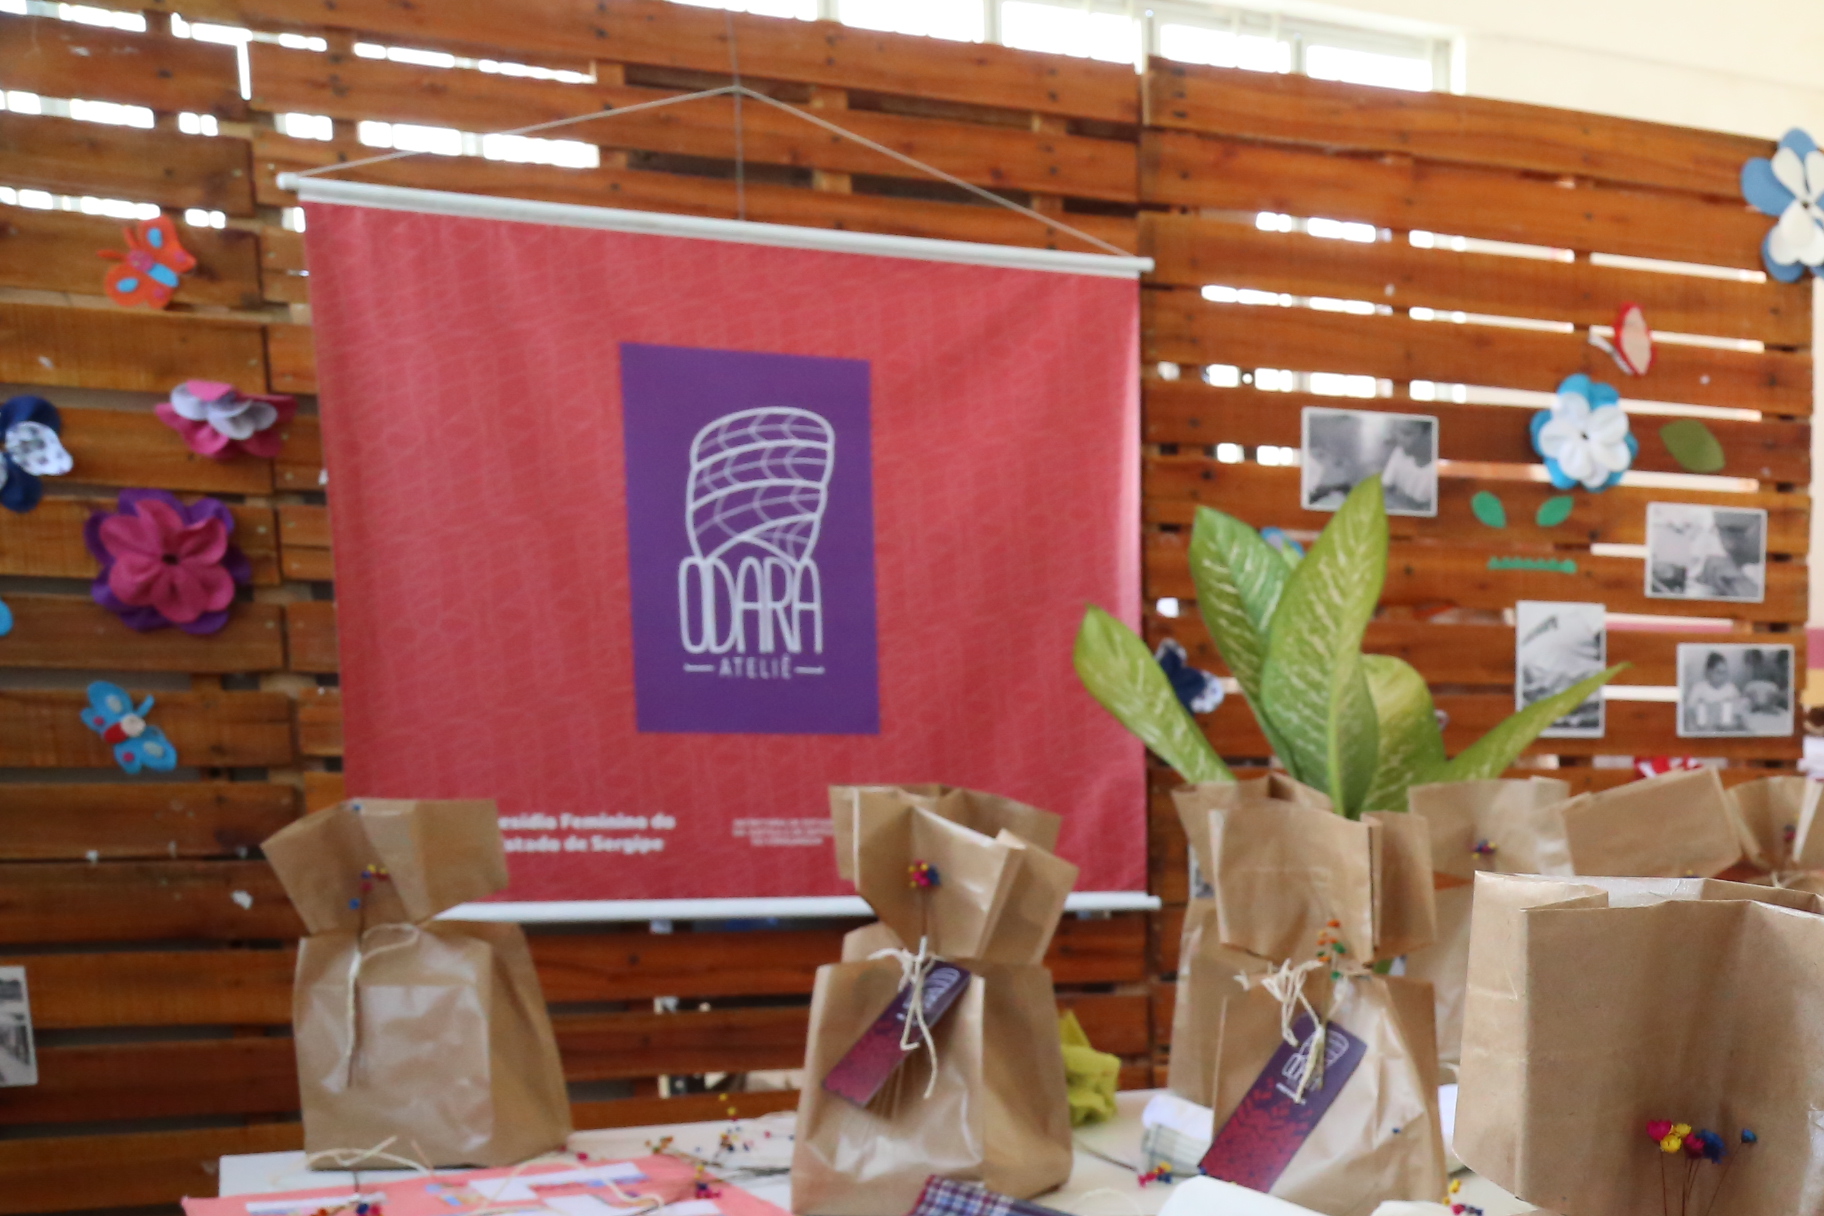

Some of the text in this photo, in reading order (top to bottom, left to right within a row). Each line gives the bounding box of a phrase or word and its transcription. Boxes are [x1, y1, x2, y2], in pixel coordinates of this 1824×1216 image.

[678, 555, 824, 654] ODARA
[650, 811, 676, 830] do
[503, 834, 664, 855] stado de Sergipe
